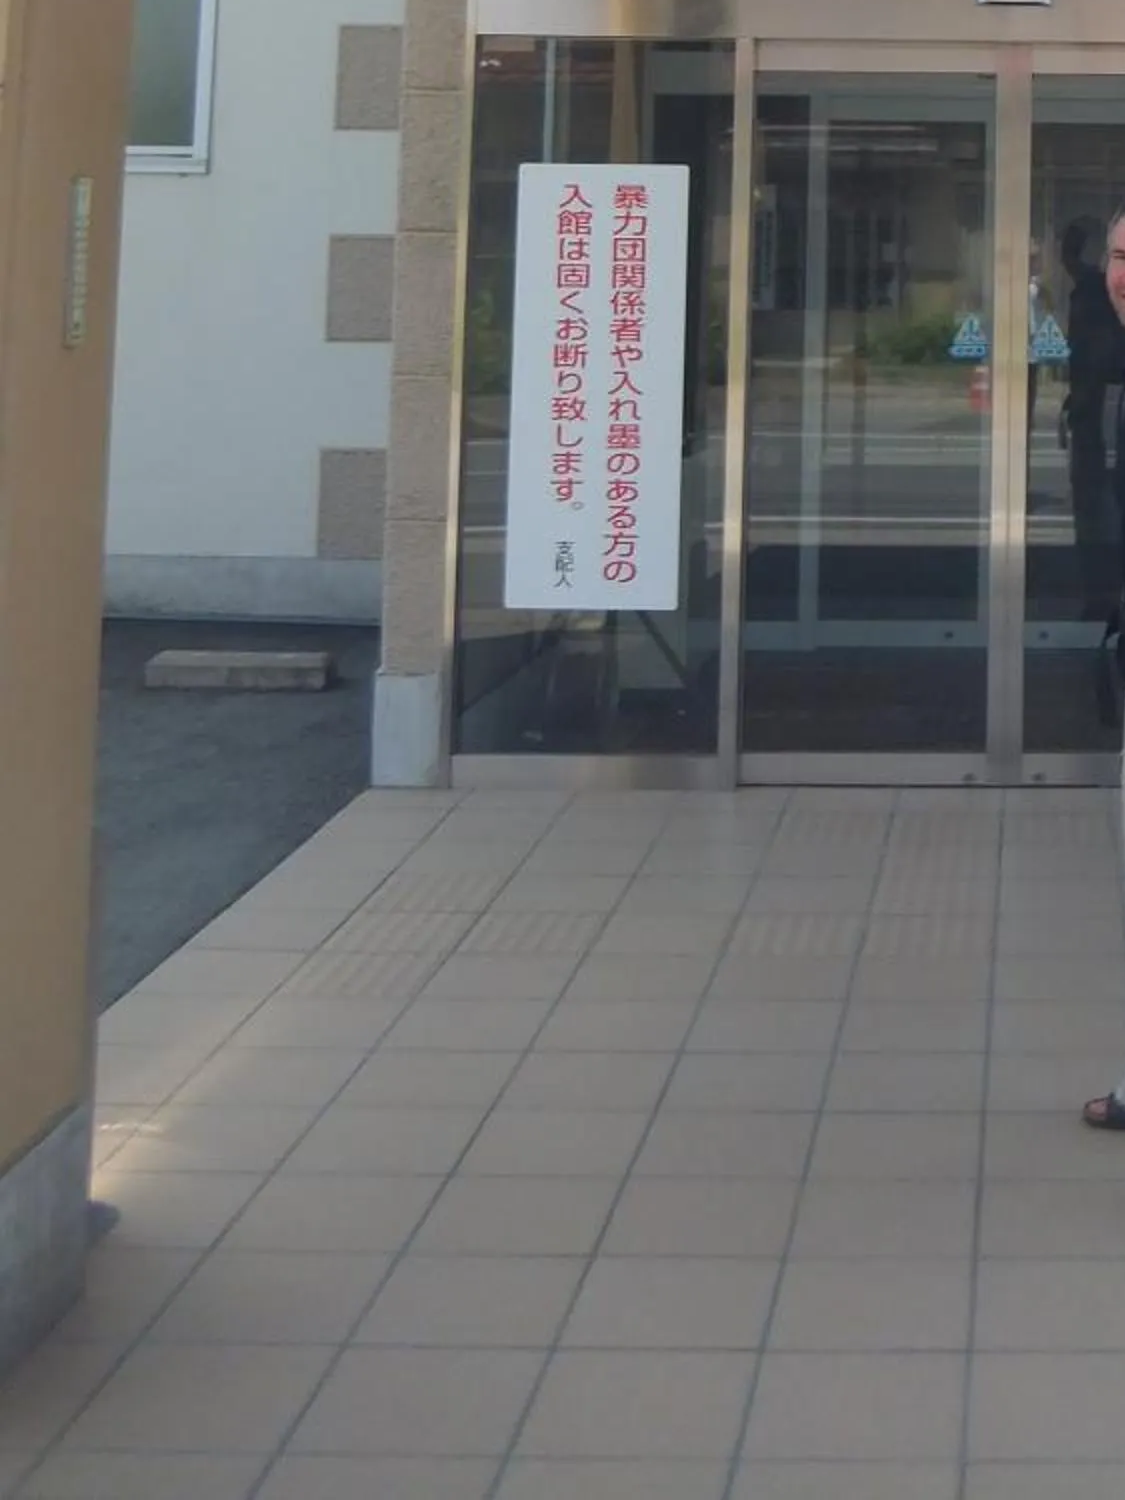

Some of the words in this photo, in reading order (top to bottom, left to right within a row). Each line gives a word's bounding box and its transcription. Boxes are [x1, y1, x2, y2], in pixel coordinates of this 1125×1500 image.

[550, 184, 593, 511] 入館は固くお断り致します。
[602, 184, 649, 584] 暴力団関係者や入れ墨のある方の
[553, 541, 577, 588] 支配人
